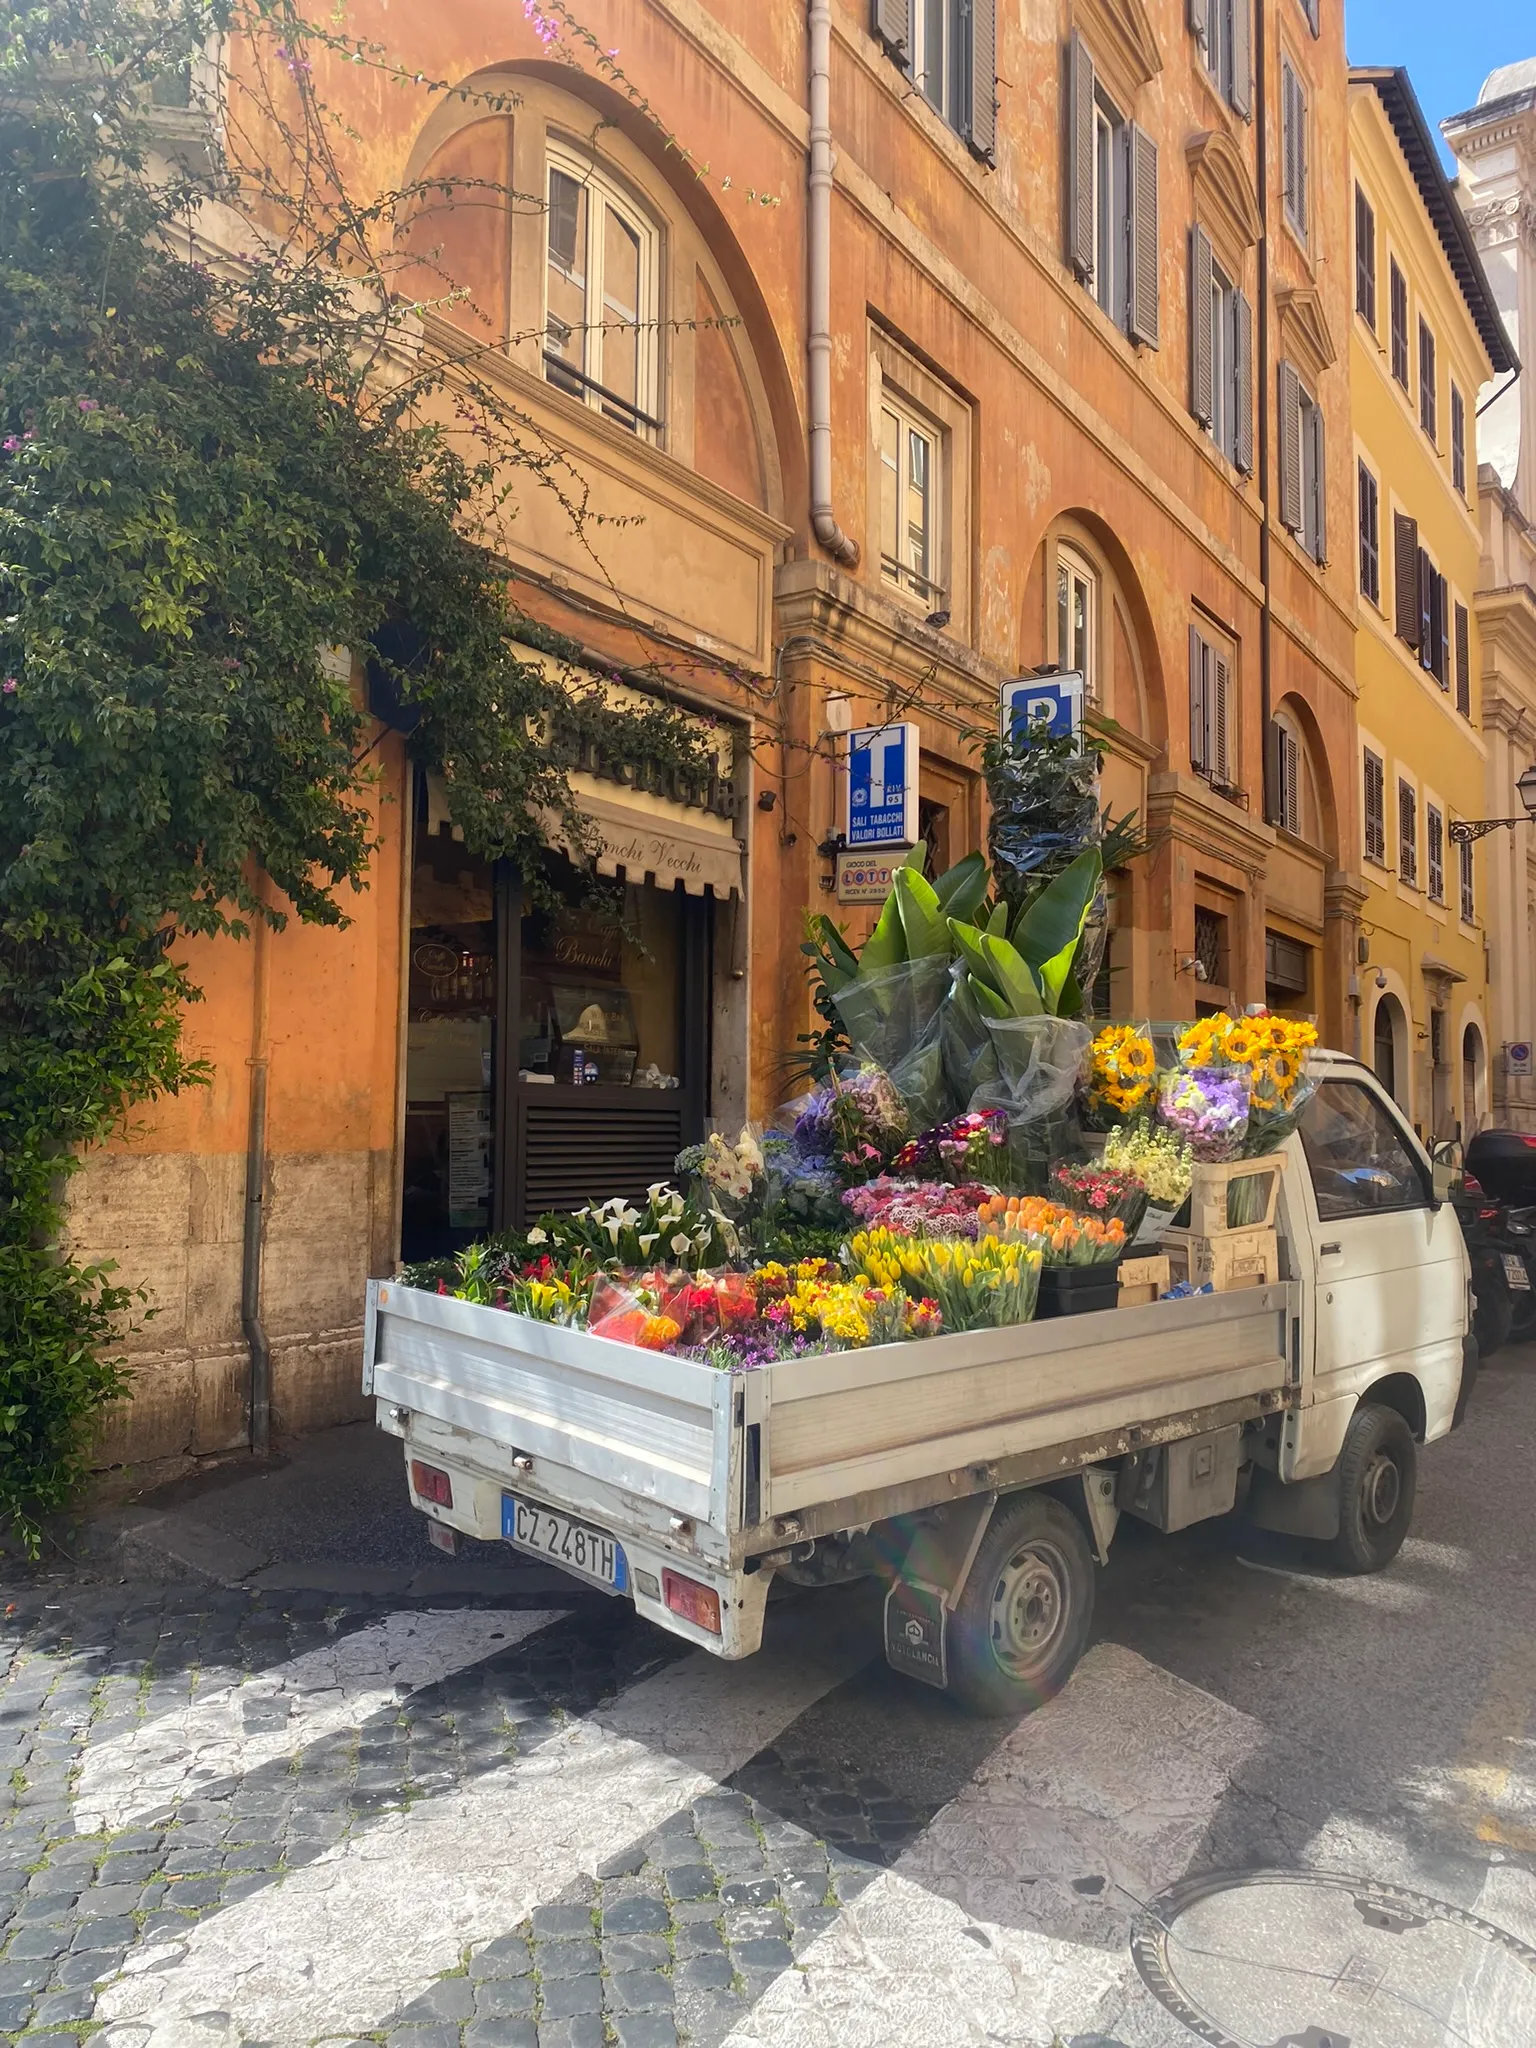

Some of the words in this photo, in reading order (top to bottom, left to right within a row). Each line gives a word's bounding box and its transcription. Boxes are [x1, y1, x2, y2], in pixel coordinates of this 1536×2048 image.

[1027, 697, 1058, 732] P
[855, 730, 902, 809] T
[888, 796, 899, 804] 95
[852, 815, 867, 827] SALI
[870, 811, 903, 826] TABACCHI
[851, 827, 875, 841] VALORI
[876, 825, 903, 838] BOLLATI
[651, 838, 703, 874] Vecchi
[846, 861, 865, 869] GIOCO
[865, 859, 878, 867] DEL
[843, 869, 892, 885] LOTT
[555, 935, 613, 968] Banchi
[517, 1507, 540, 1547] CZ
[547, 1518, 614, 1581] 248TH
